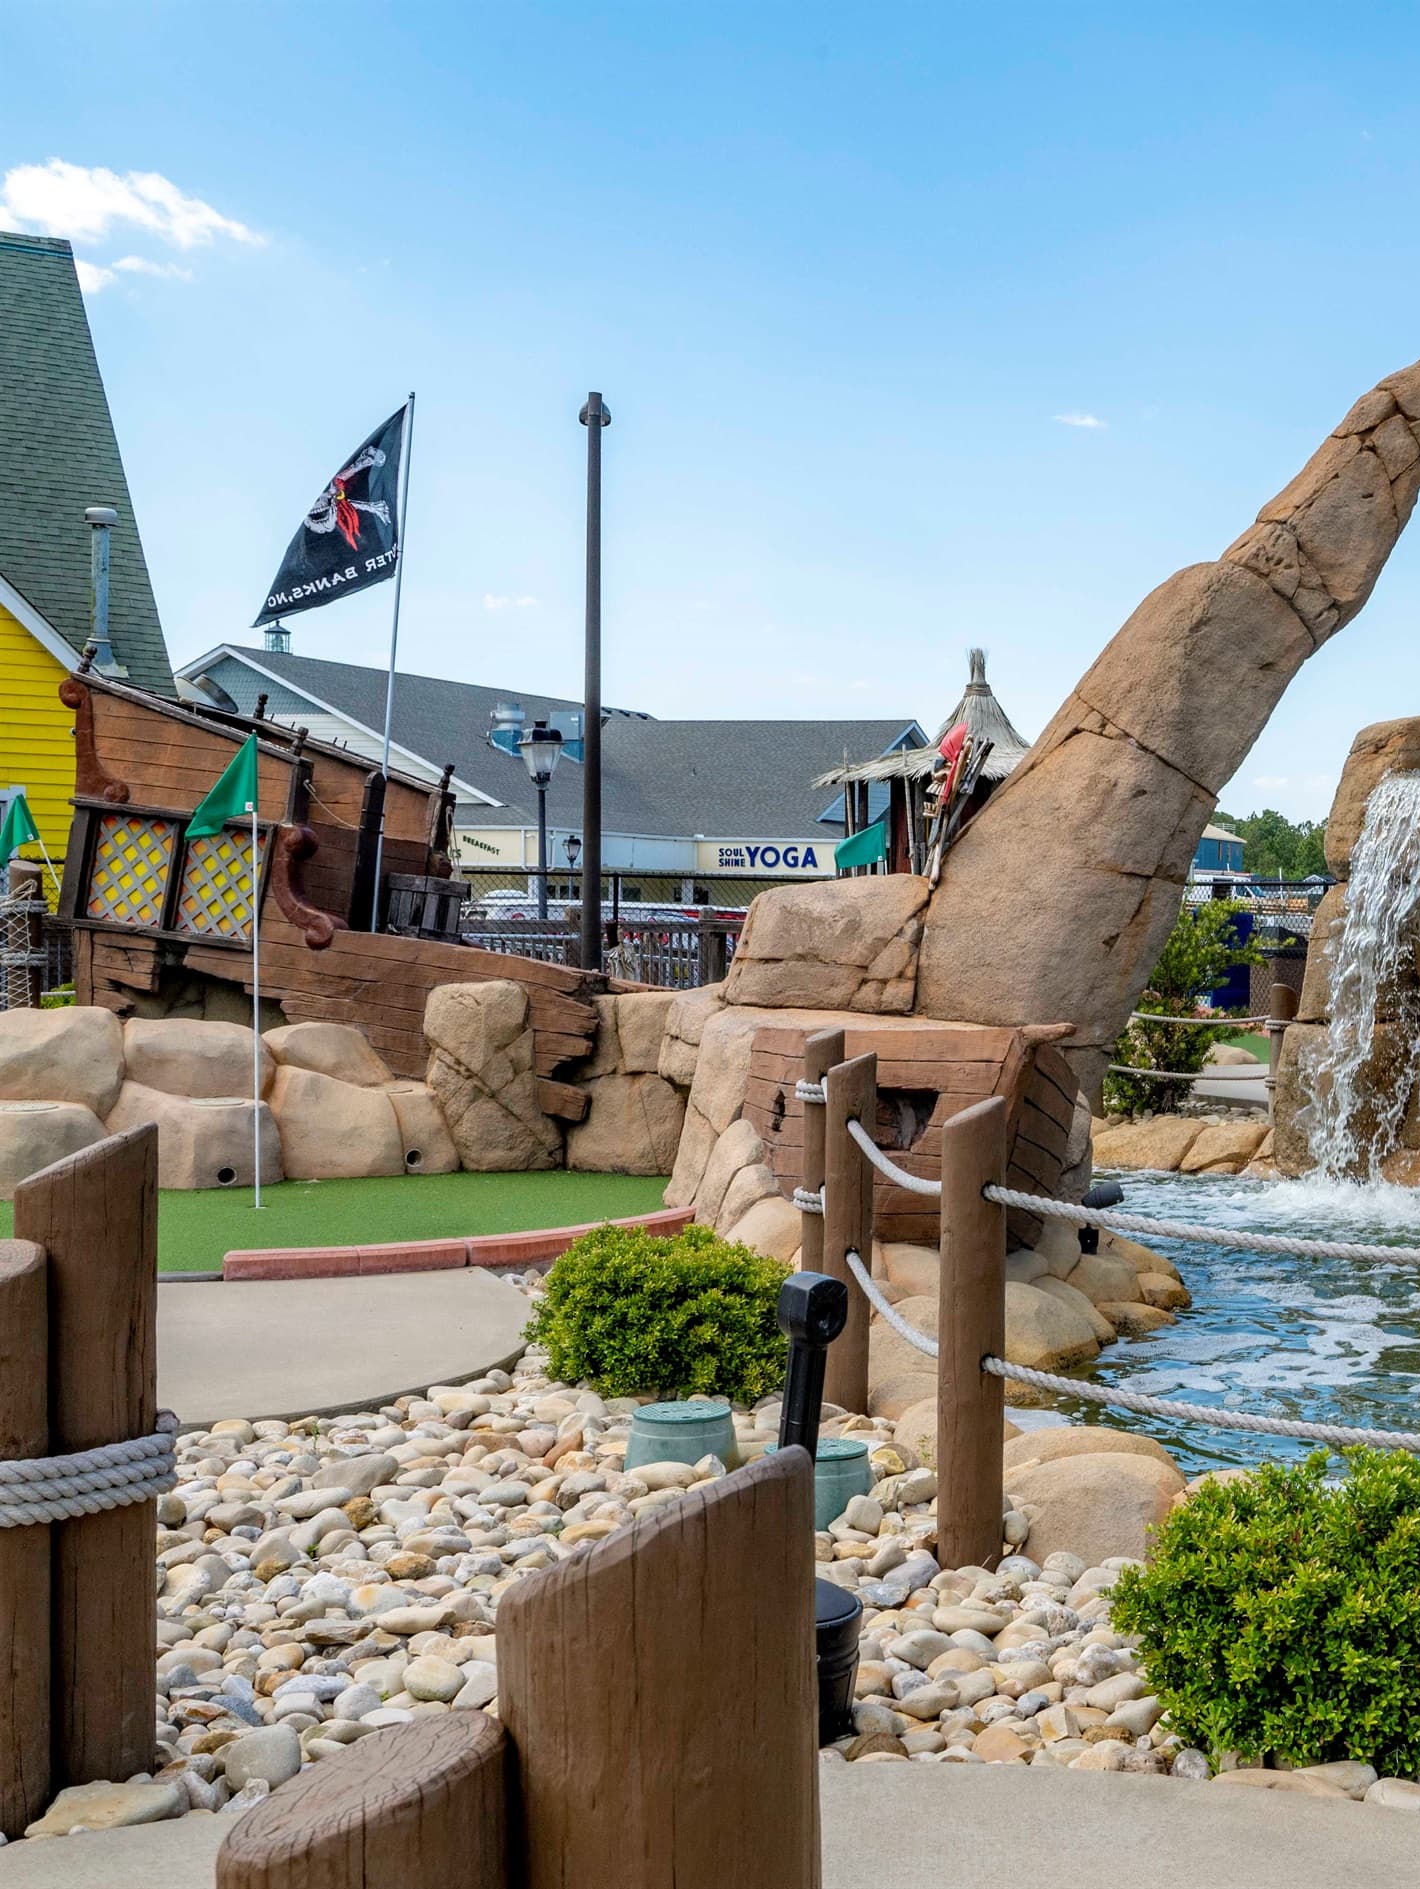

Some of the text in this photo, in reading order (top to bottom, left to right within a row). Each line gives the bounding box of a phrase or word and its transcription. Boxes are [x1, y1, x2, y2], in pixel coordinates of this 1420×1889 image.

[463, 835, 500, 855] BREAKFAST
[719, 848, 744, 857] SOUL
[745, 846, 818, 868] YOGA
[719, 858, 745, 867] SHINE
